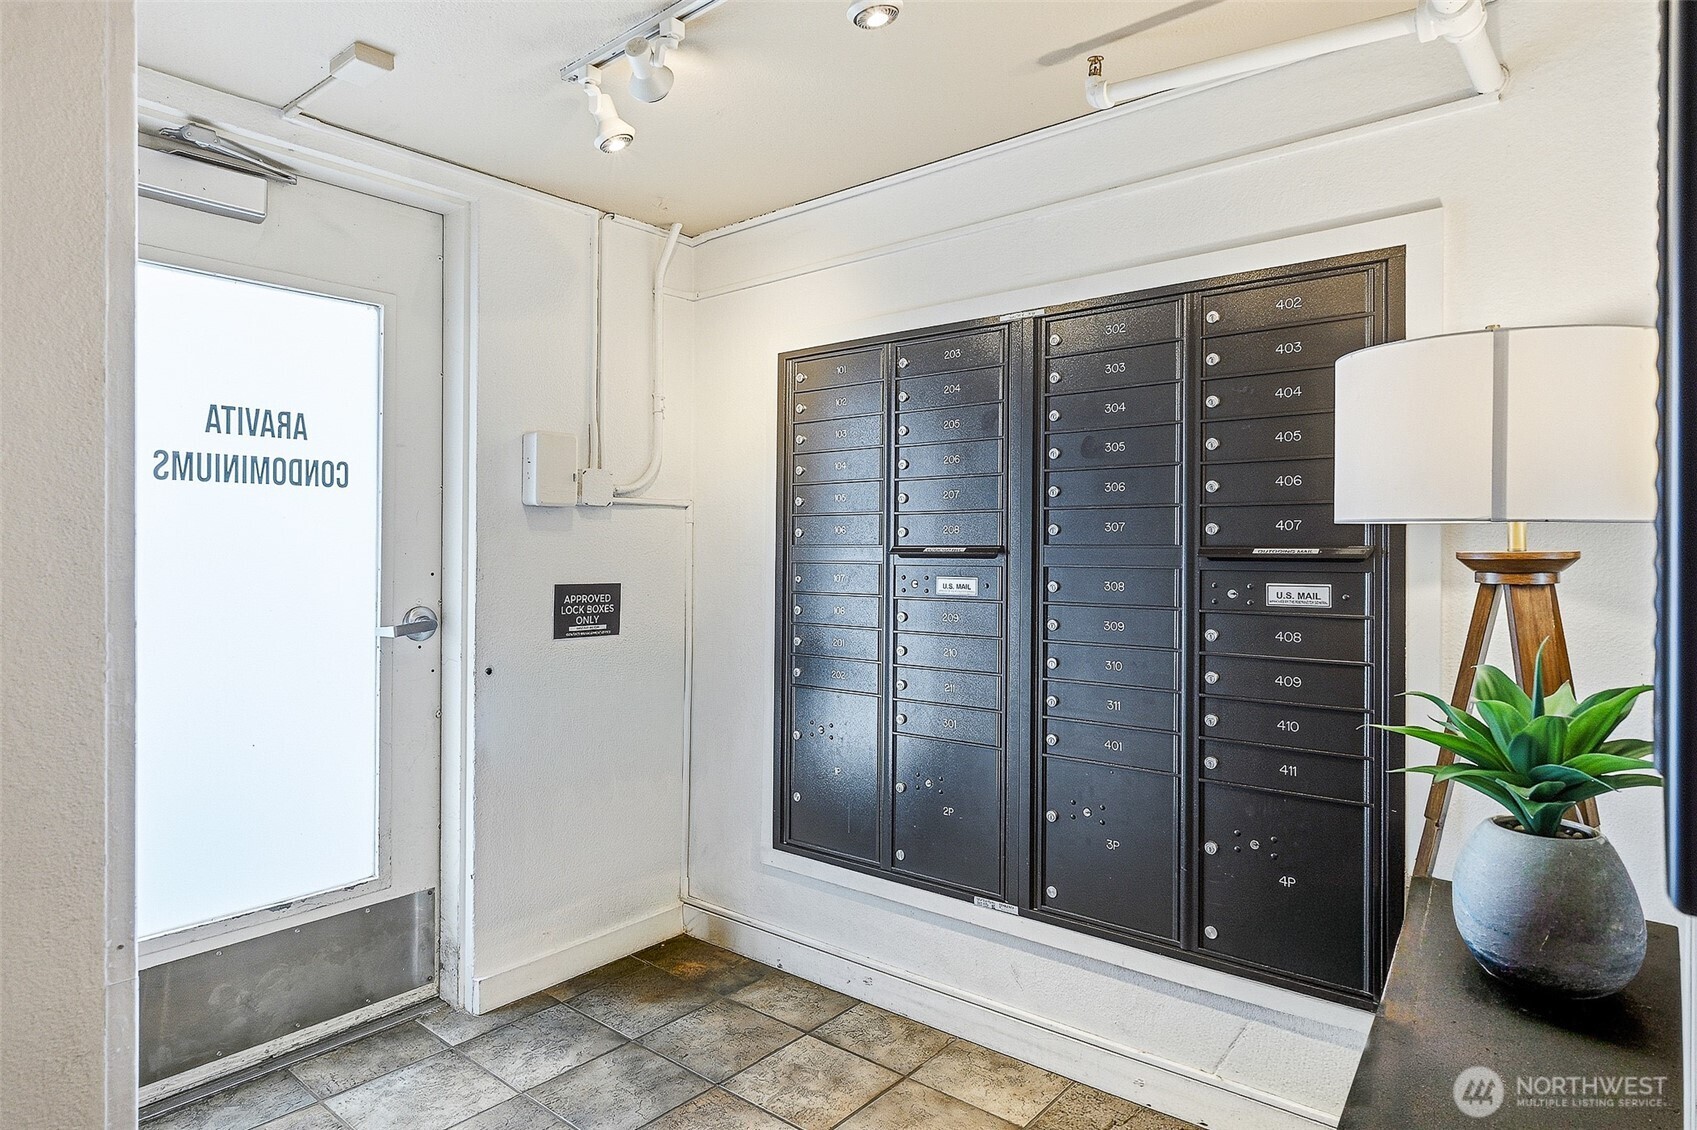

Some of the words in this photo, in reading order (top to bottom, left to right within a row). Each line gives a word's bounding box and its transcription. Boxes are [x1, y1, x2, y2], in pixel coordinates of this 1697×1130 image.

[1275, 297, 1302, 310] 402
[1105, 323, 1126, 335] 302
[1275, 342, 1302, 354] 403
[944, 349, 961, 359] 203
[1104, 362, 1126, 374] 303
[943, 384, 961, 394] 204
[1275, 386, 1302, 398] 404
[835, 397, 847, 406] 102
[1104, 402, 1126, 413] 304
[943, 420, 960, 429] 205
[835, 430, 847, 438] 103
[1275, 430, 1302, 443] 405
[1104, 441, 1126, 453] 305
[943, 455, 960, 464] 206
[834, 462, 847, 470] 104
[1275, 475, 1302, 487] 406
[1104, 481, 1126, 493] 306
[942, 490, 960, 499] 207
[942, 525, 960, 535] 208
[1104, 522, 1126, 533] 307
[1275, 519, 1302, 531] 407
[956, 583, 972, 591] MAIL
[1103, 581, 1125, 592] 308
[563, 593, 612, 604] APPROVED
[1276, 592, 1295, 600] U.S.
[1297, 592, 1322, 601] MAIL
[561, 605, 585, 615] LOCK
[586, 604, 615, 614] BOXES
[575, 615, 600, 625] ONLY
[942, 613, 959, 623] 209
[1103, 621, 1125, 632] 309
[832, 638, 845, 647] 201
[1275, 631, 1302, 644] 408
[943, 648, 957, 657] 210
[1105, 660, 1123, 672] 310
[831, 671, 846, 679] 202
[944, 683, 955, 692] 211
[1275, 676, 1302, 688] 409
[1107, 700, 1121, 711] 311
[942, 719, 957, 729] 301
[1276, 720, 1300, 733] 410
[1104, 740, 1123, 752] 401
[1279, 765, 1297, 777] 411
[943, 806, 955, 816] 2P
[1106, 839, 1120, 850] 3P
[1278, 876, 1296, 888] 4P
